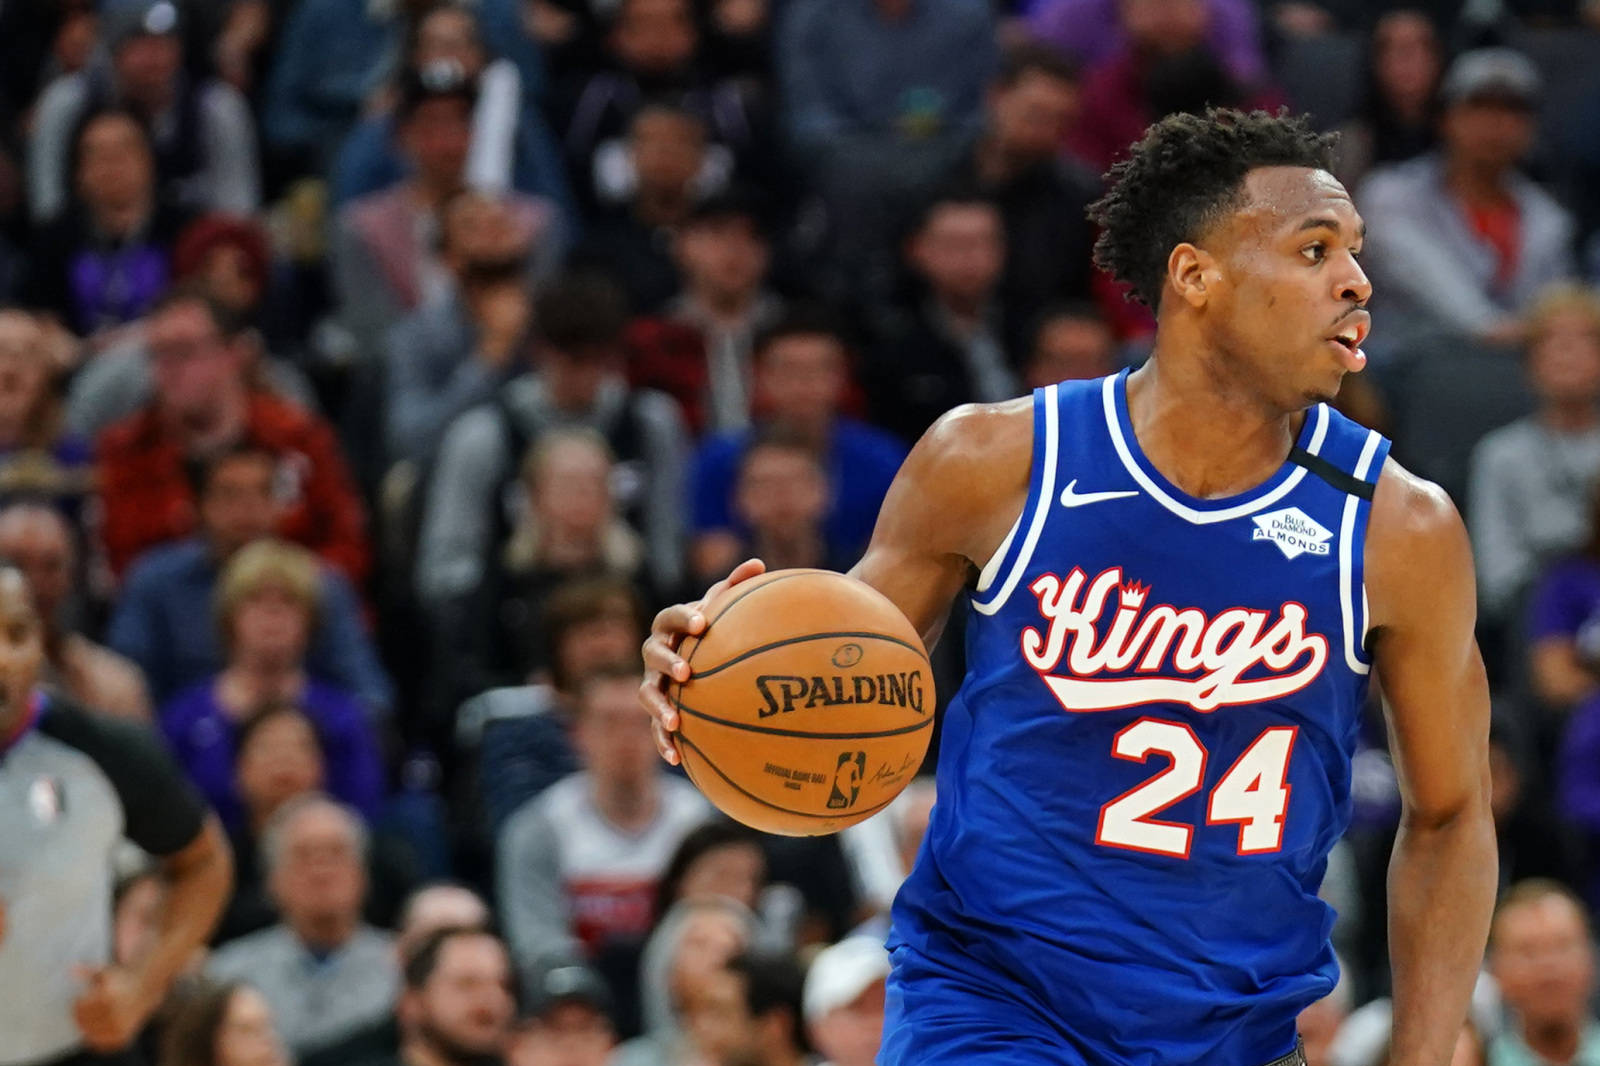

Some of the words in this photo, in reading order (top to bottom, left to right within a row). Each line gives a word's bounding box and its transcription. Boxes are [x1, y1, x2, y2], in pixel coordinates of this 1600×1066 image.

[1256, 529, 1327, 553] ALMONDS
[1021, 565, 1329, 712] Kings
[756, 670, 924, 718] SPALDING
[1094, 716, 1299, 859] 24
